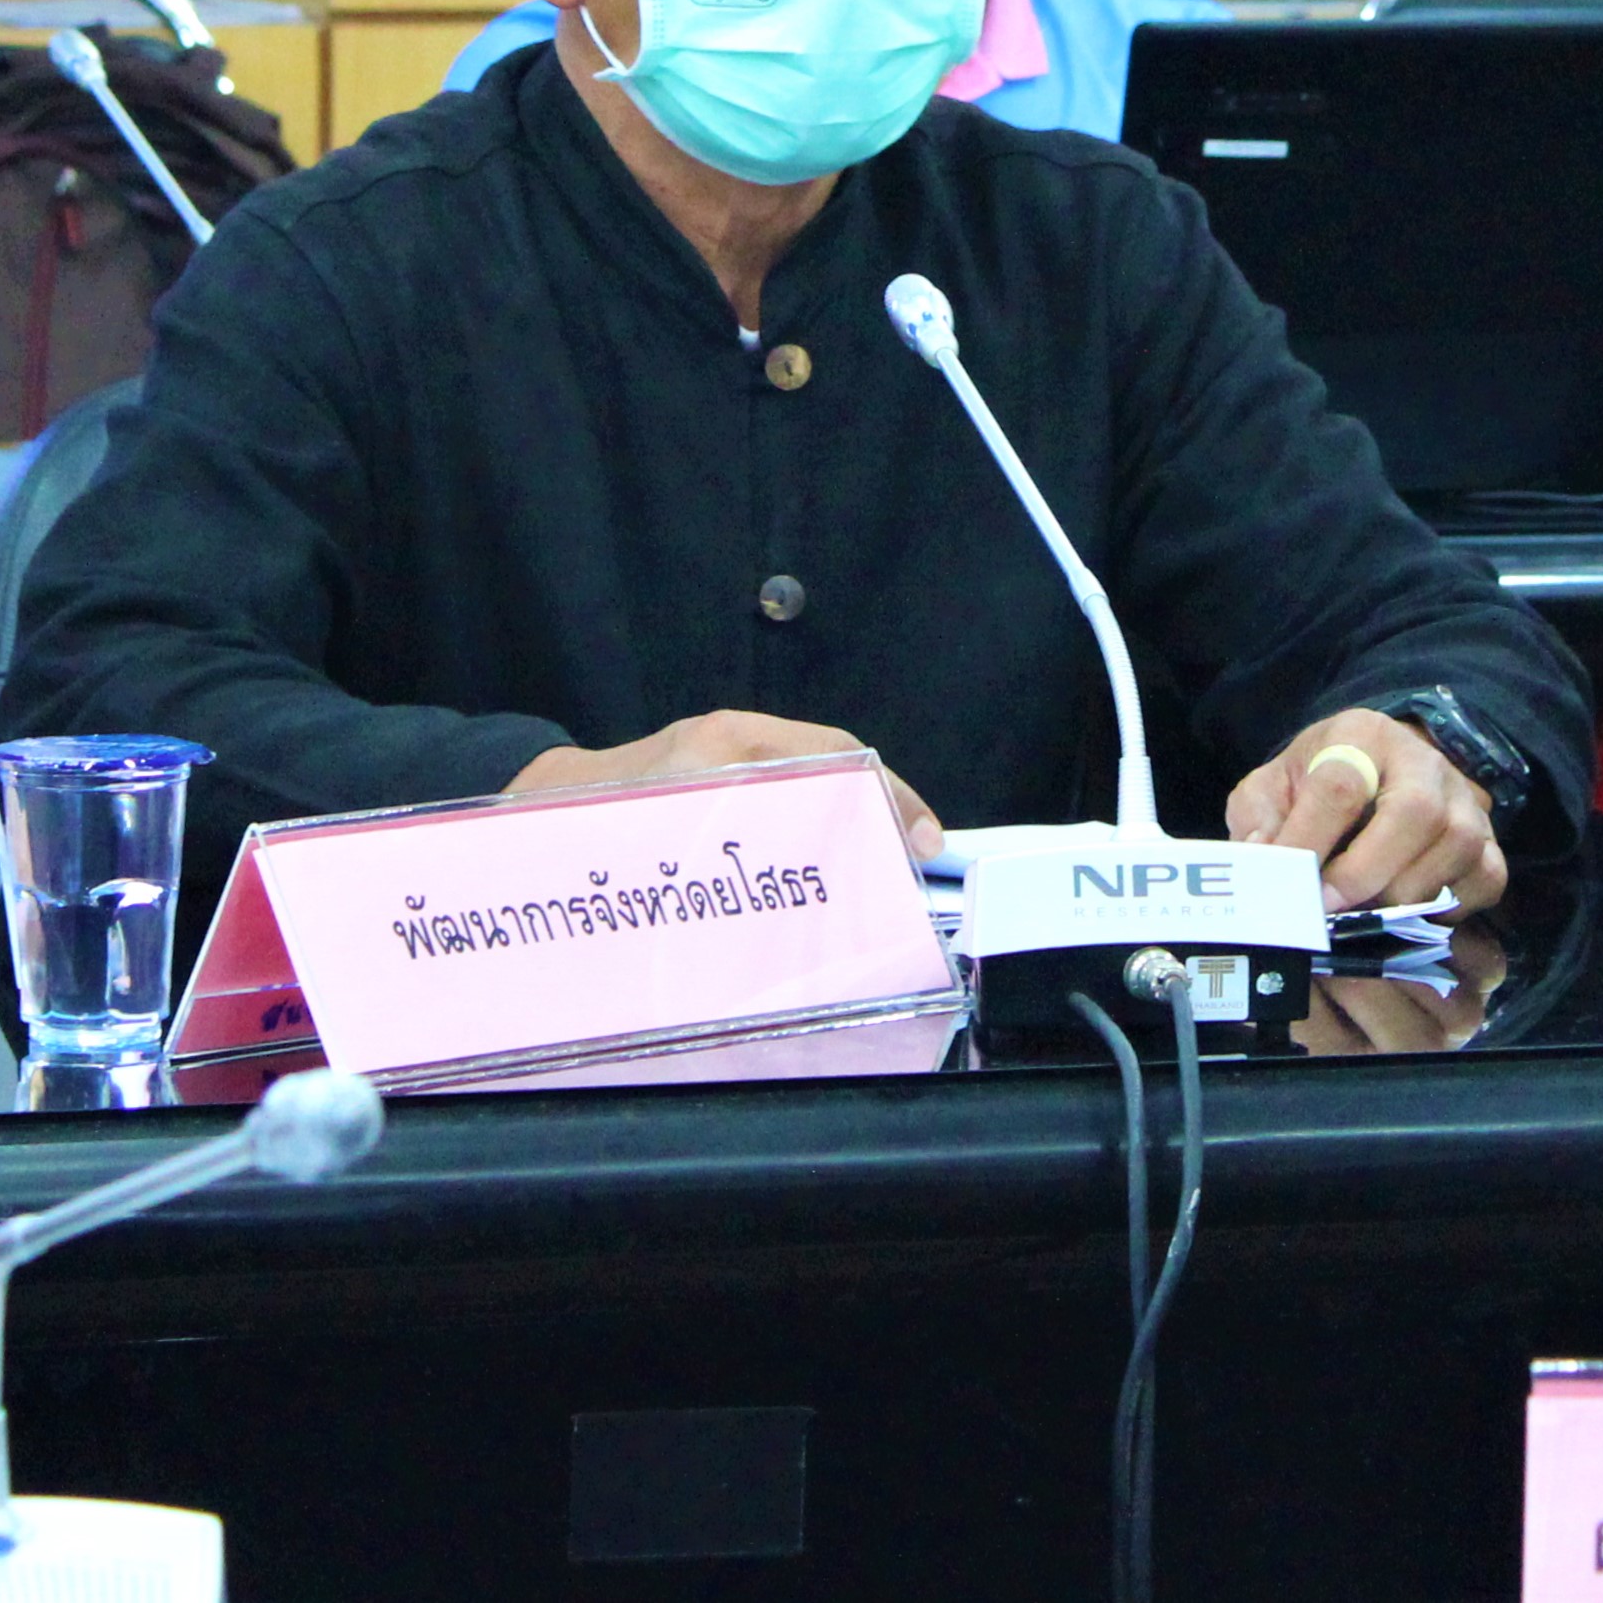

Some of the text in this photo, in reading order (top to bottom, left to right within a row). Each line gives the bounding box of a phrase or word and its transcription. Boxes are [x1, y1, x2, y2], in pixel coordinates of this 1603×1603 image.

[1072, 862, 1235, 899] NPE
[393, 841, 830, 962] พัฒนาการจังหวัดยโสธร
[1073, 905, 1237, 918] RESEARCH
